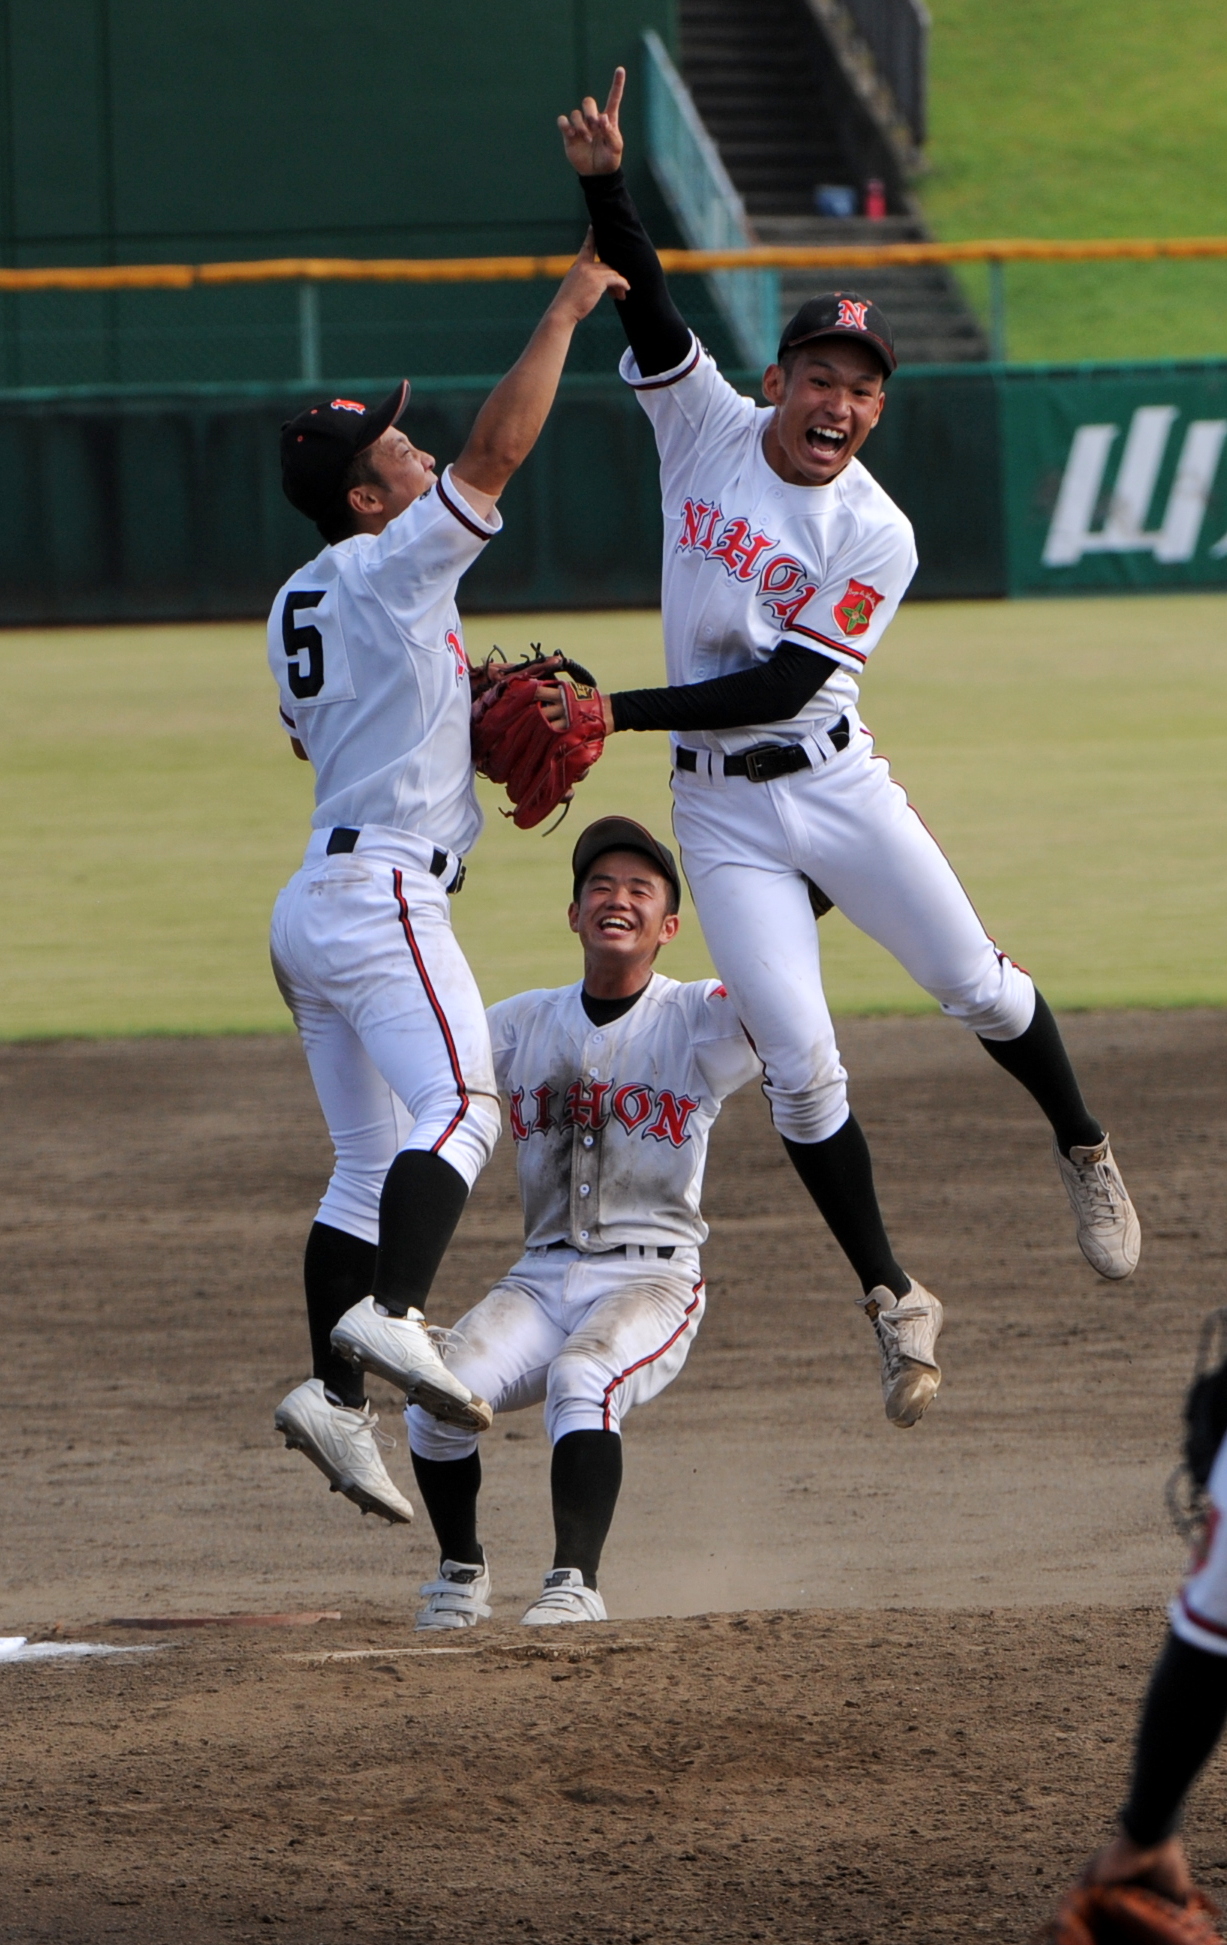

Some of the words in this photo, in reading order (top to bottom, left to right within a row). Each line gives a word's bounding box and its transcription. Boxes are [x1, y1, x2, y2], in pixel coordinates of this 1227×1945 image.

[835, 299, 868, 330] N
[1041, 405, 1227, 567] 山
[282, 590, 327, 699] 5
